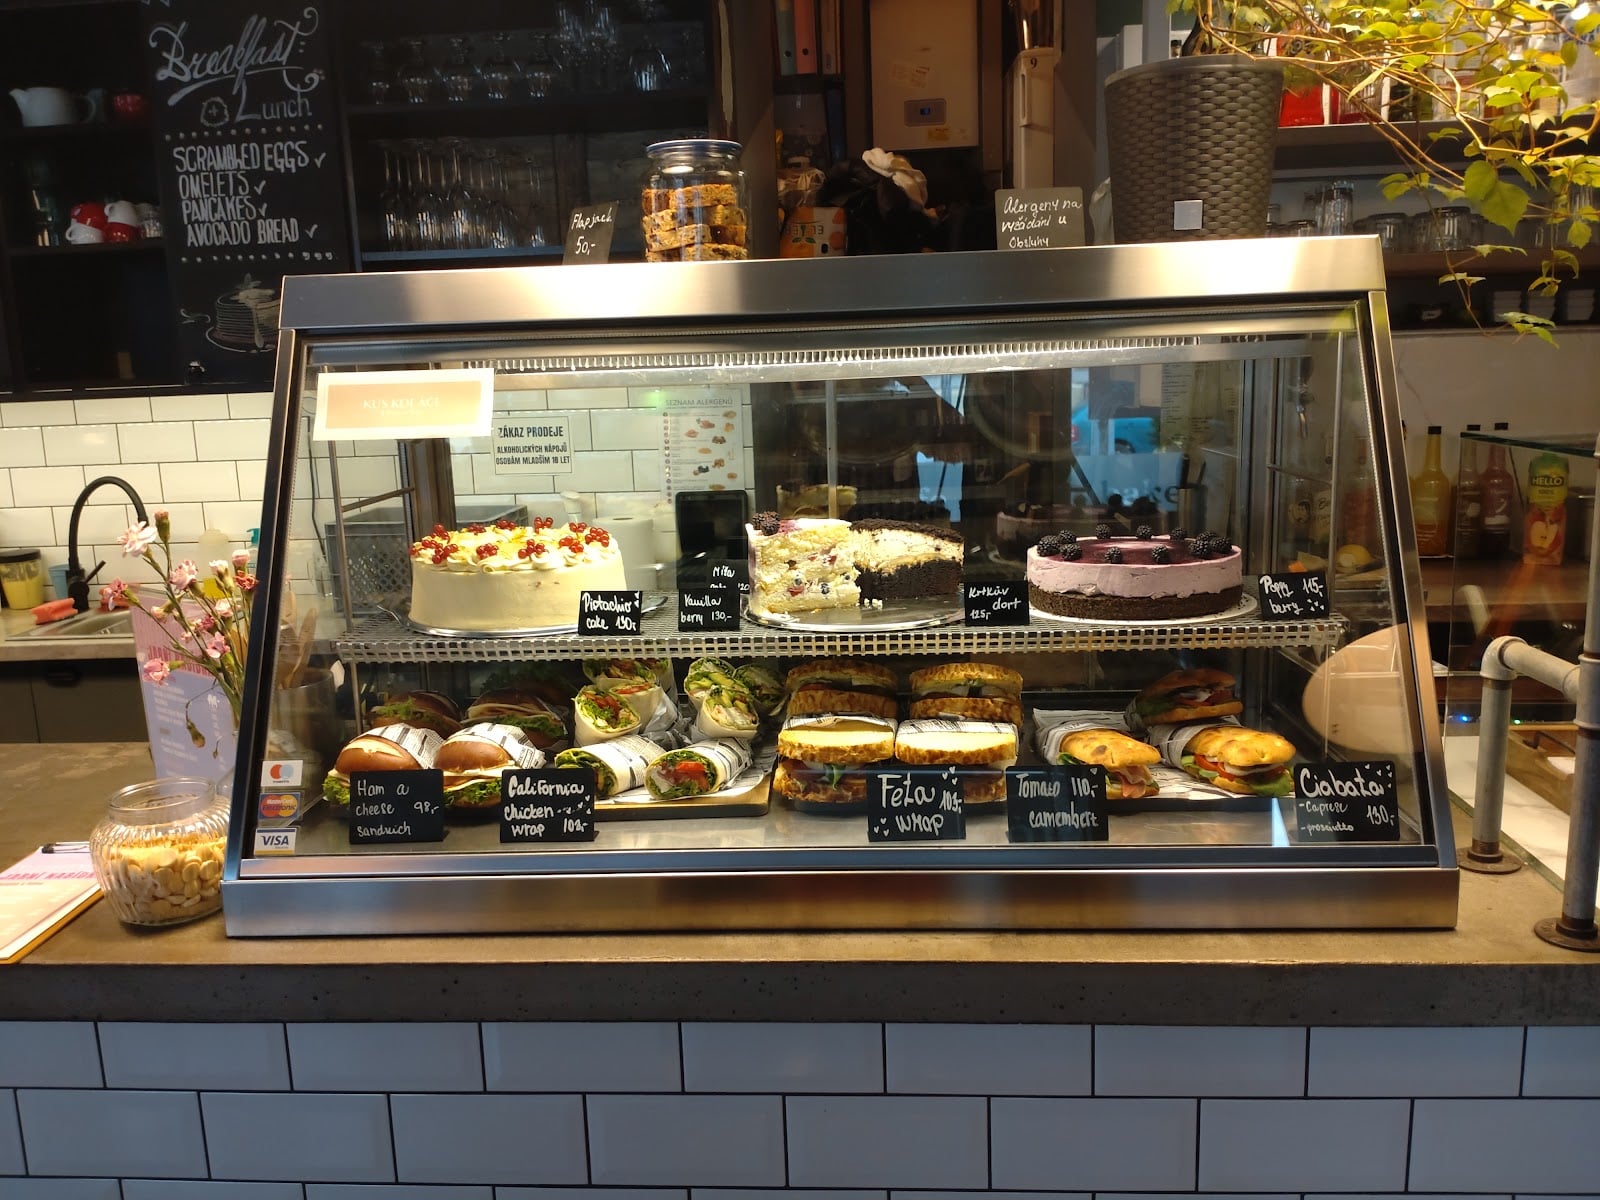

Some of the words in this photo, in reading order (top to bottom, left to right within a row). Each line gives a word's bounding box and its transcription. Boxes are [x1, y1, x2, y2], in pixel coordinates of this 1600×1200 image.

[149, 12, 316, 98] Breakfast
[236, 79, 310, 121] Lunch
[173, 143, 260, 172] SCRAMBLED
[264, 141, 309, 172] EGGS
[179, 171, 250, 199] OMELETS
[181, 196, 257, 224] PANCAKES
[1003, 196, 1059, 217] Alergeny
[1062, 200, 1082, 210] na
[571, 207, 613, 230] Flapjack
[1058, 215, 1067, 224] u
[187, 220, 251, 247] AVOCADO
[257, 218, 299, 245] BREAD
[498, 425, 525, 438] ZÁKAZ
[526, 425, 564, 438] PRODEJE
[497, 444, 543, 454] ALKOHOLICKÝCH
[544, 442, 568, 453] NÁPOJŮ
[495, 456, 521, 465] OSOBÁM
[522, 454, 551, 464] MLADŠÍM
[551, 456, 559, 464] 18
[560, 456, 570, 464] LET
[1531, 476, 1563, 487] HELLO
[582, 592, 632, 613] Pistachio
[684, 593, 721, 607] Vanilla
[992, 597, 1022, 610] dort
[1269, 599, 1304, 615] berry
[586, 614, 609, 630] cake
[680, 611, 703, 625] berry
[357, 780, 385, 797] Ham
[396, 783, 409, 795] a
[877, 772, 935, 808] Feta
[1016, 773, 1061, 798] Tomato
[356, 801, 395, 817] cheese
[1028, 801, 1099, 828] camembert
[357, 821, 411, 838] sandwich
[511, 823, 545, 837] wrap
[262, 836, 289, 846] VISA
